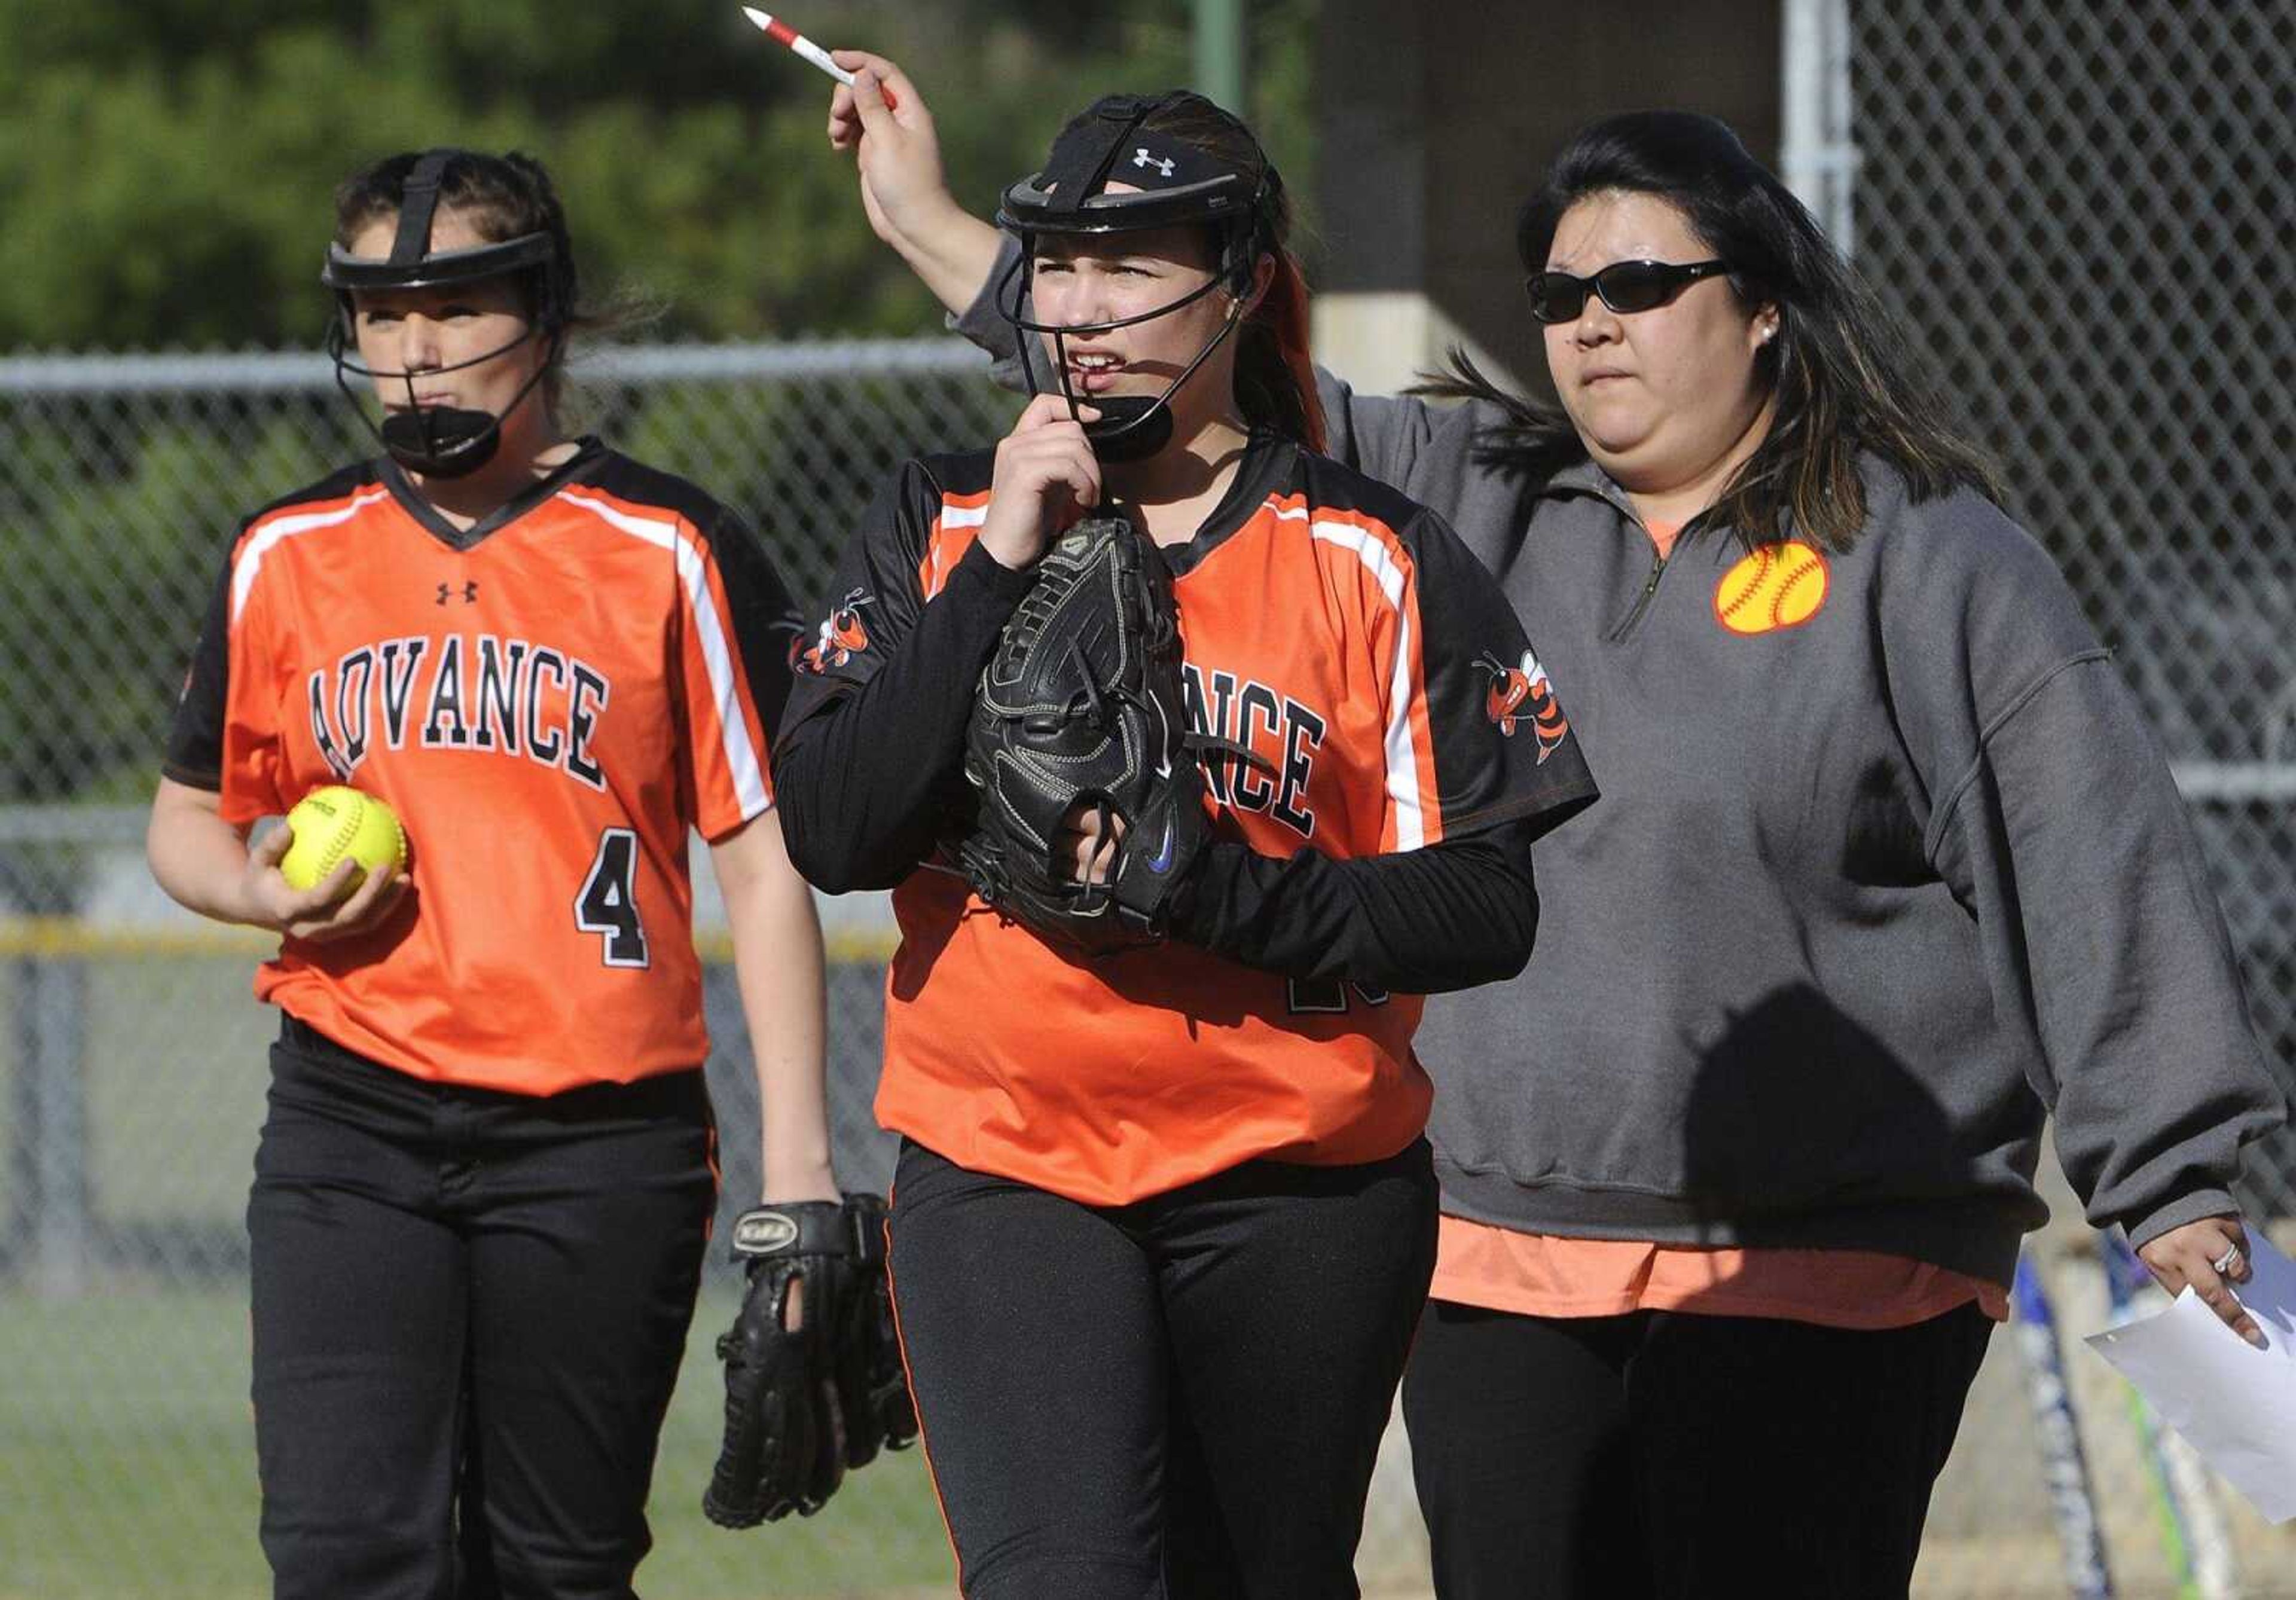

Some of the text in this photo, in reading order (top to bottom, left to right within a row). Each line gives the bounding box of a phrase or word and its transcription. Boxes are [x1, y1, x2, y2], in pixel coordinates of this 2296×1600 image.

[309, 634, 609, 792] ADVANCE
[1181, 661, 1326, 839] NCE
[574, 826, 649, 969] 4
